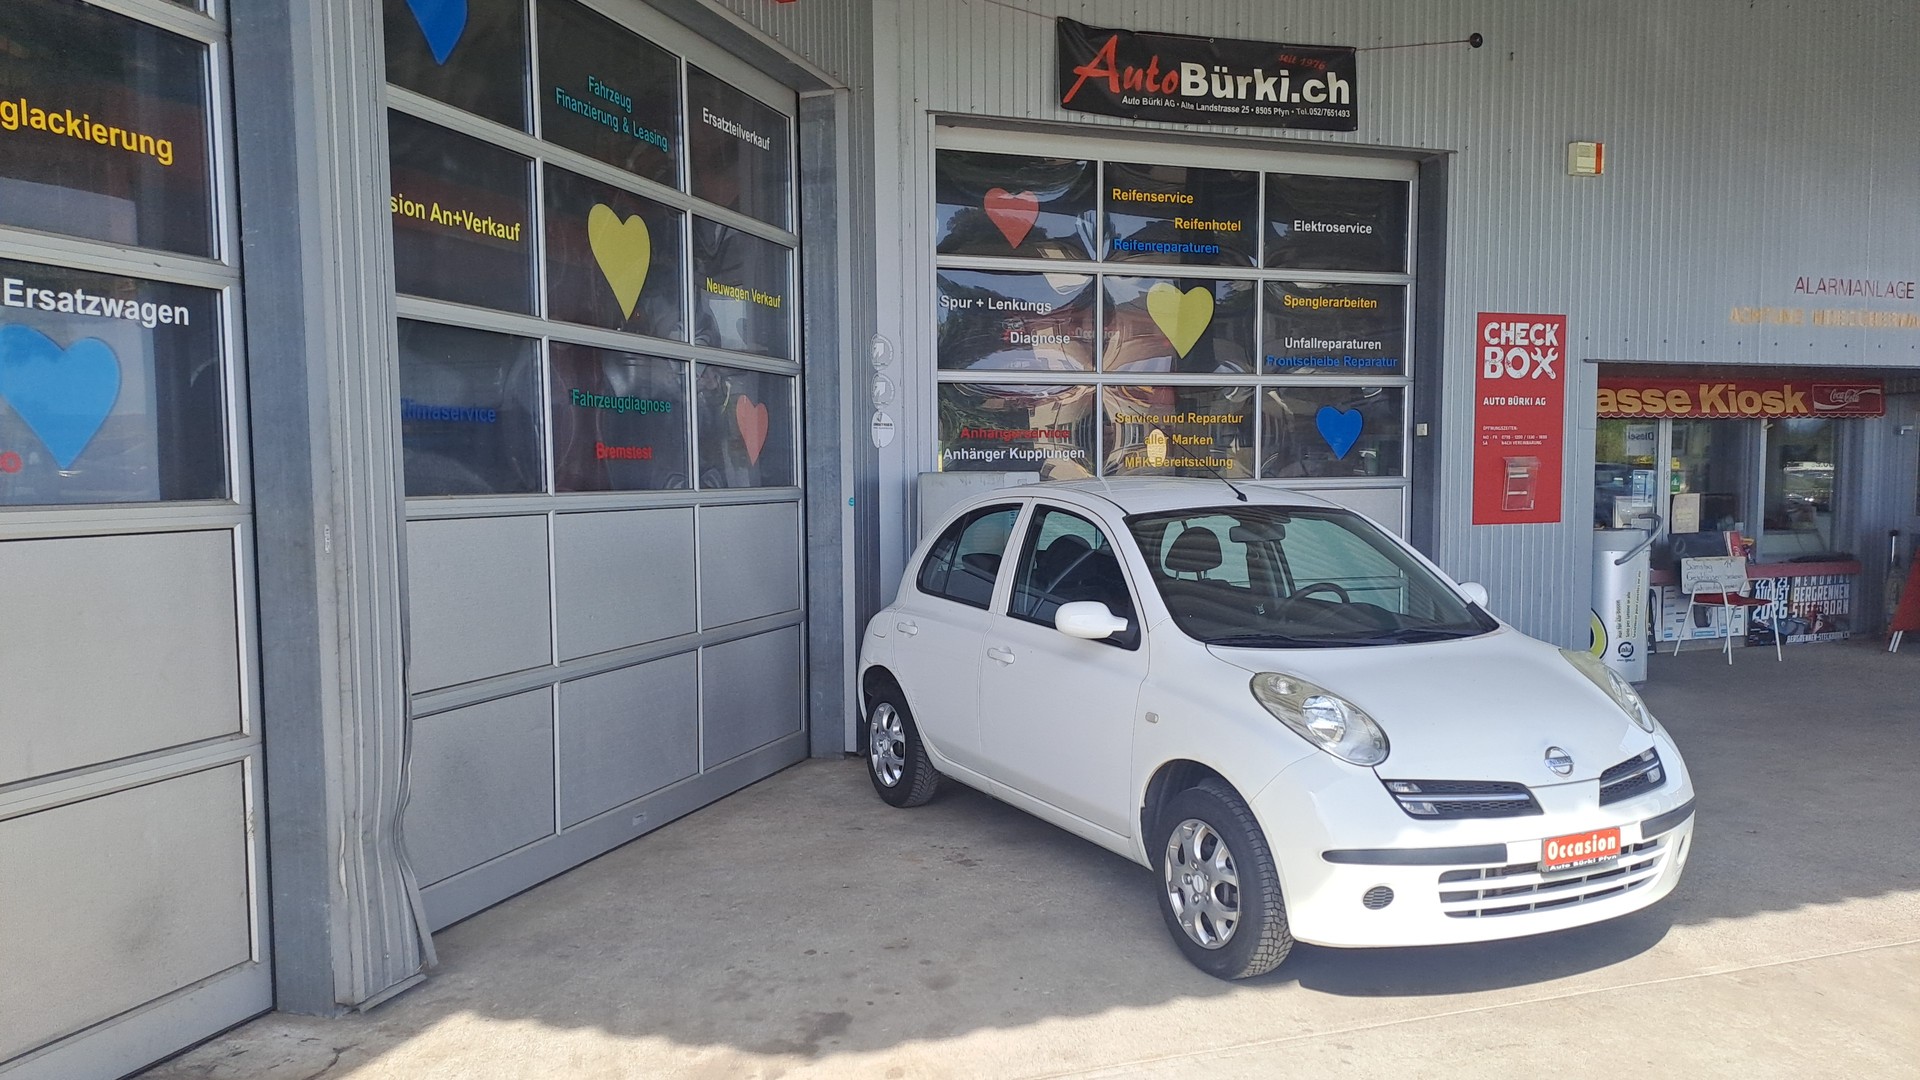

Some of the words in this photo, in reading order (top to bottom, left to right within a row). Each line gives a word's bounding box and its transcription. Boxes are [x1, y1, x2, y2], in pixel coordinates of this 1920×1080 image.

[588, 75, 632, 114] Fahrzeug
[1122, 95, 1140, 106] Auto
[1142, 97, 1163, 107] Bürki
[1164, 98, 1176, 108] AG
[1180, 101, 1195, 110] Alte
[1196, 103, 1240, 113] Landstrasse
[1241, 105, 1250, 114] 25
[1255, 106, 1272, 116] 8505
[1273, 107, 1290, 117] Pfyn
[556, 87, 619, 133] Finanzierung
[622, 117, 630, 133] &
[632, 121, 669, 153] Leasing
[702, 107, 771, 151] Ersatzteilverkauf
[0, 98, 174, 166] glackierung
[1112, 188, 1194, 205] Reifenservice
[429, 202, 521, 241] An+Verkauf
[1174, 217, 1242, 232] Reifenhotel
[1294, 220, 1373, 235] Elektroservice
[1113, 238, 1220, 255] Reifenreparaturen
[706, 276, 750, 303] Neuwagen
[751, 287, 781, 309] Verkauf
[1794, 276, 1915, 299] ALARMANLAGE
[2, 278, 190, 328] Ersatzwagen
[940, 295, 972, 311] Spur
[976, 299, 984, 308] +
[988, 298, 1052, 315] Lenkungs
[1283, 294, 1378, 310] Spenglerarbeiten
[1010, 331, 1071, 346] Diagnose
[1284, 337, 1382, 351] Unfallreparaturen
[1484, 321, 1560, 347] CHECK
[1265, 355, 1340, 368] Frontscheibe
[1343, 355, 1398, 369] Reparatur
[1483, 346, 1559, 380] BOX
[572, 389, 672, 415] Fahrzeugdiagnose
[1483, 397, 1506, 406] AUTO
[1507, 395, 1533, 406] BÜRKI
[1535, 397, 1546, 406] AG
[1700, 384, 1807, 414] Kiosk
[1114, 413, 1159, 425] Service
[1162, 413, 1185, 425] und
[1188, 413, 1243, 425] Reparatur
[1144, 435, 1166, 446] aller
[1172, 435, 1213, 446] Marken
[596, 442, 653, 460] Bremstest
[943, 447, 1007, 463] Anhänger
[1009, 447, 1085, 464] Kupplungen
[1547, 834, 1616, 860] Occasion
[1549, 862, 1570, 871] Auto
[1598, 854, 1617, 863] Pfyn
